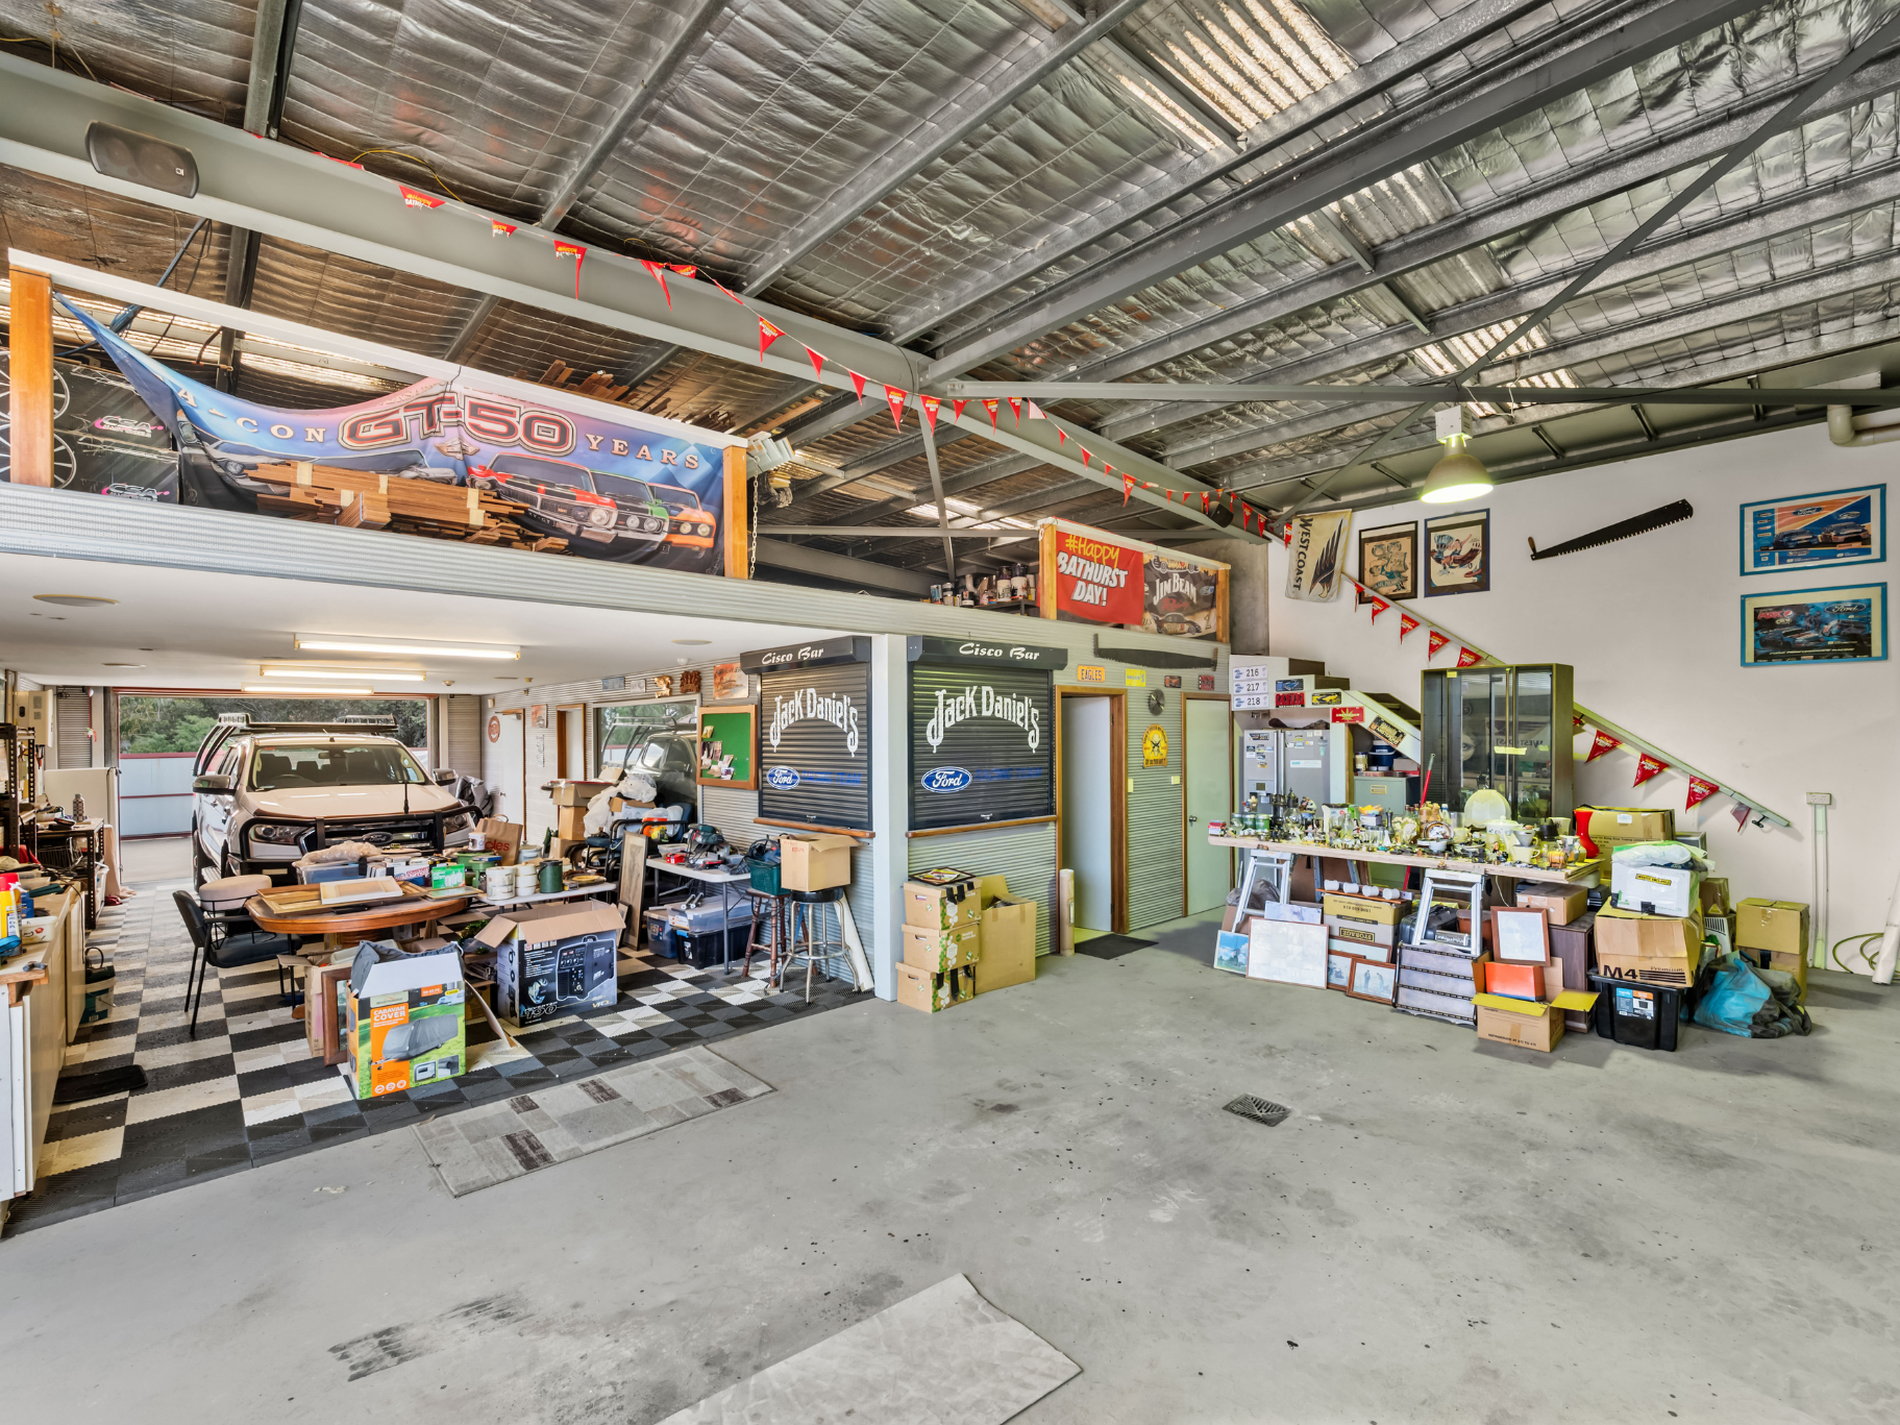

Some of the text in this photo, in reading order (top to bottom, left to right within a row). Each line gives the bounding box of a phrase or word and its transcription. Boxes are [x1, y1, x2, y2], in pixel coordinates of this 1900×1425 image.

[337, 391, 578, 457] GT-50
[585, 433, 699, 470] YEARS
[1065, 534, 1120, 569] #Happy
[1293, 517, 1313, 591] WEST COAST
[1057, 551, 1128, 588] BATHURST
[1071, 580, 1108, 607] DAY!
[1153, 572, 1198, 606] JIM BEAM
[1831, 604, 1858, 612] Ford
[762, 646, 824, 665] Cisco Bar
[958, 643, 1040, 661] Cisco Bar
[1081, 669, 1102, 681] EAGLES
[1246, 668, 1259, 677] 216
[1246, 683, 1260, 691] 217
[1247, 697, 1261, 706] 218
[769, 687, 859, 758] Jack Daniel's
[926, 686, 1040, 754] Jack Daniel's
[773, 769, 793, 785] Ford
[836, 772, 861, 786] TEAM
[932, 770, 963, 789] Ford
[974, 766, 1043, 781] RACING TEAM
[368, 834, 387, 843] Ford
[1341, 929, 1373, 941] STORAGE
[1604, 965, 1638, 979] M4
[373, 1011, 406, 1021] COVER
[374, 1005, 405, 1016] CARAVAN
